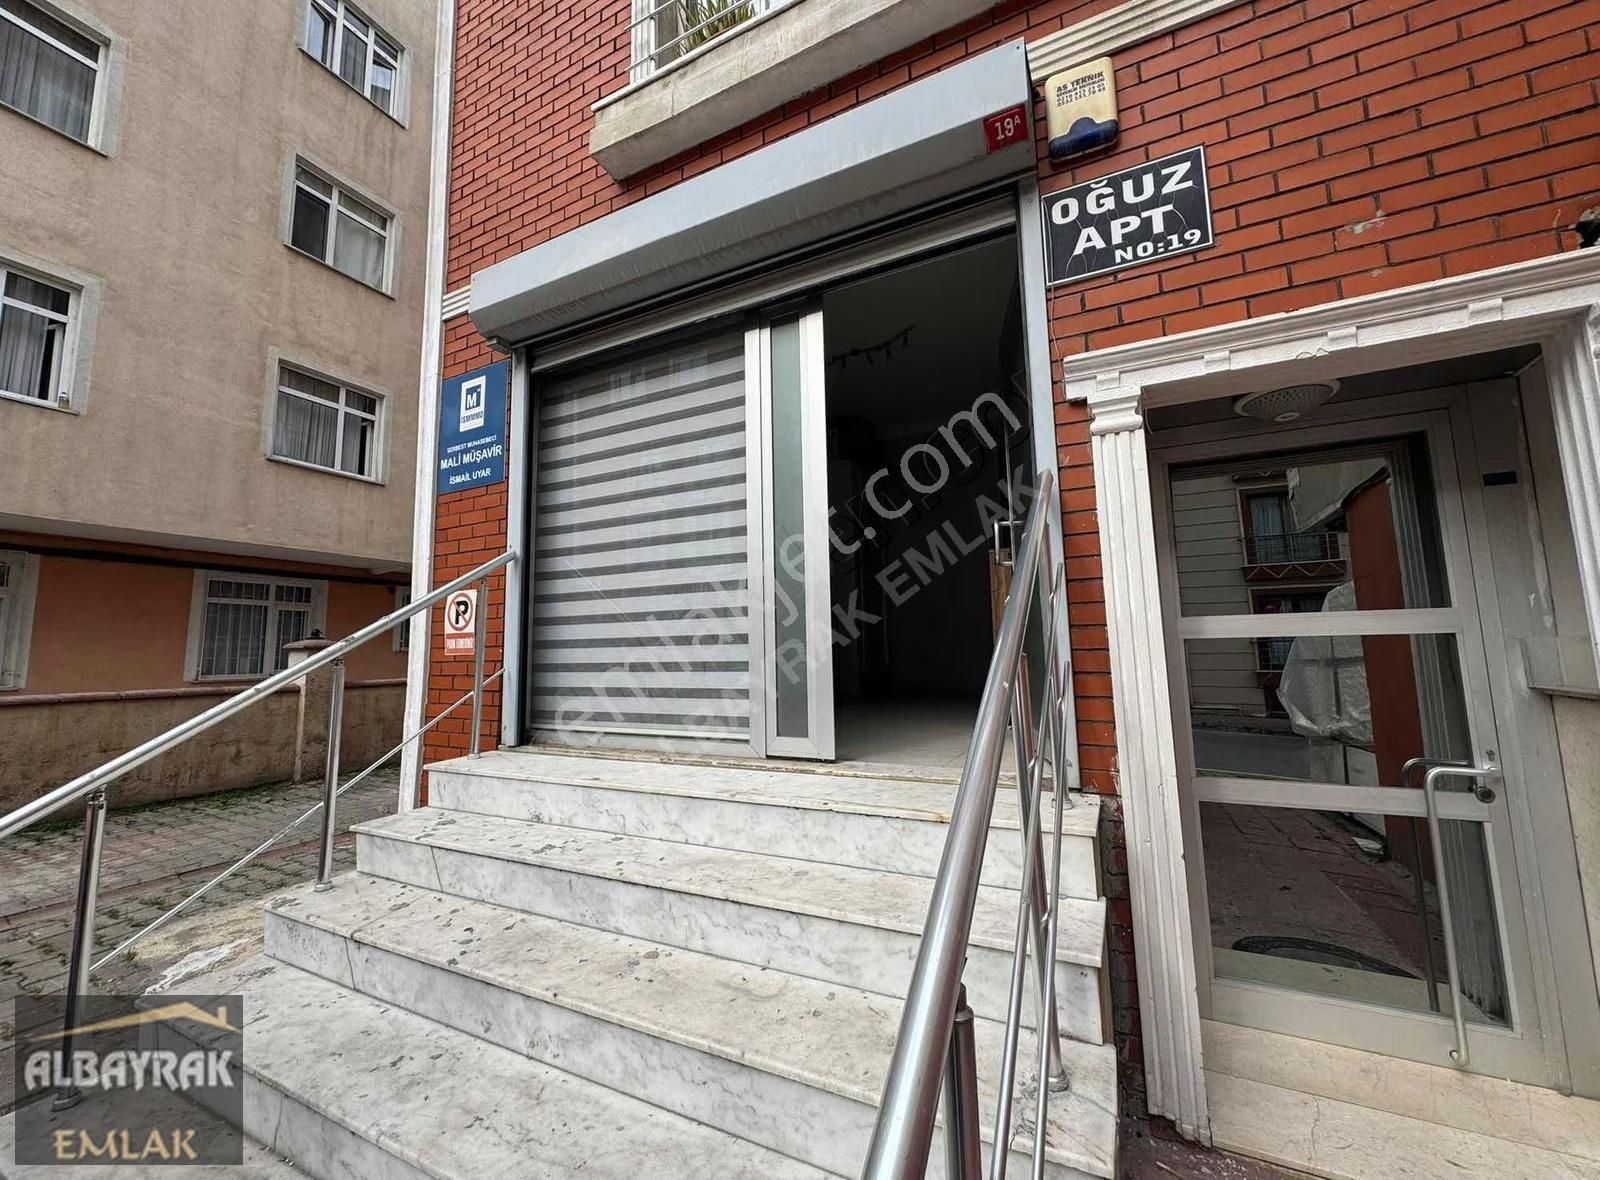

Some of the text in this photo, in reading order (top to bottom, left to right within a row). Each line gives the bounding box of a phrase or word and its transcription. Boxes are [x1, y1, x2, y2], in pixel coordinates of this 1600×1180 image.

[1051, 160, 1194, 226] OĞUZ
[1072, 203, 1175, 256] APT
[1114, 229, 1202, 264] NO:19
[440, 444, 502, 470] MALİ MÜŞAVİR
[472, 467, 491, 480] UYAR
